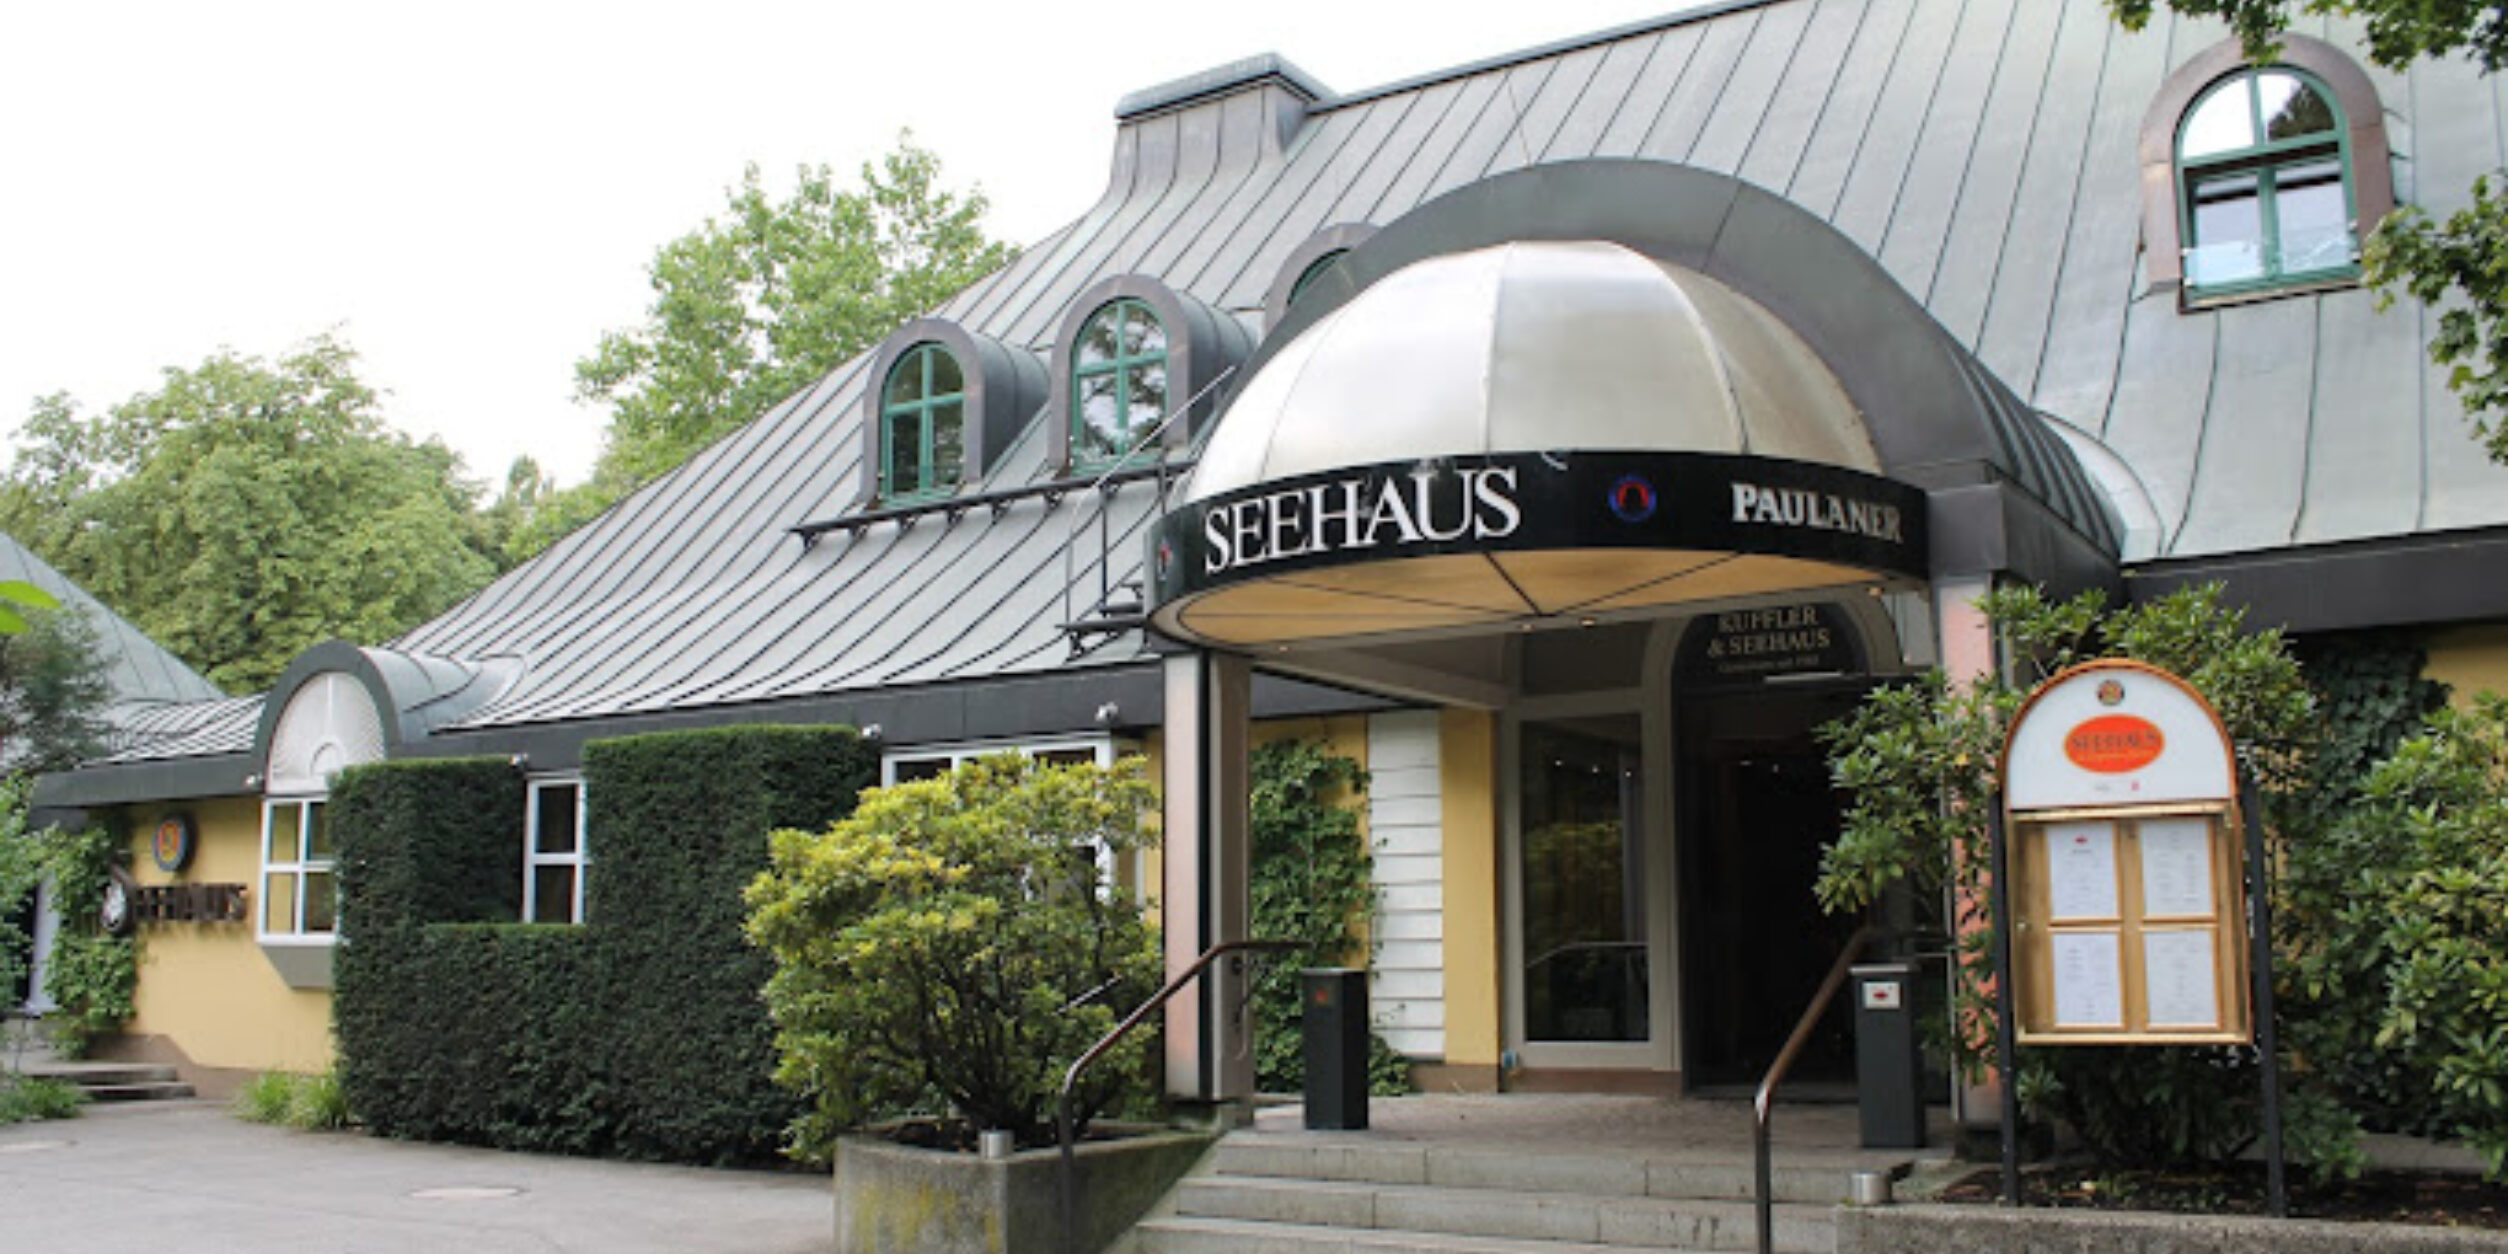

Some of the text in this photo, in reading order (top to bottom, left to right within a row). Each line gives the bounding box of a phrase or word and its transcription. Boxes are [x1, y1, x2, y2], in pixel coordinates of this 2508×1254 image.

[1204, 466, 1521, 574] SEEHAUS
[1732, 482, 1903, 544] PAULANER
[1717, 605, 1819, 633] KUFFLER
[1706, 627, 1831, 659] & SEEHAUS
